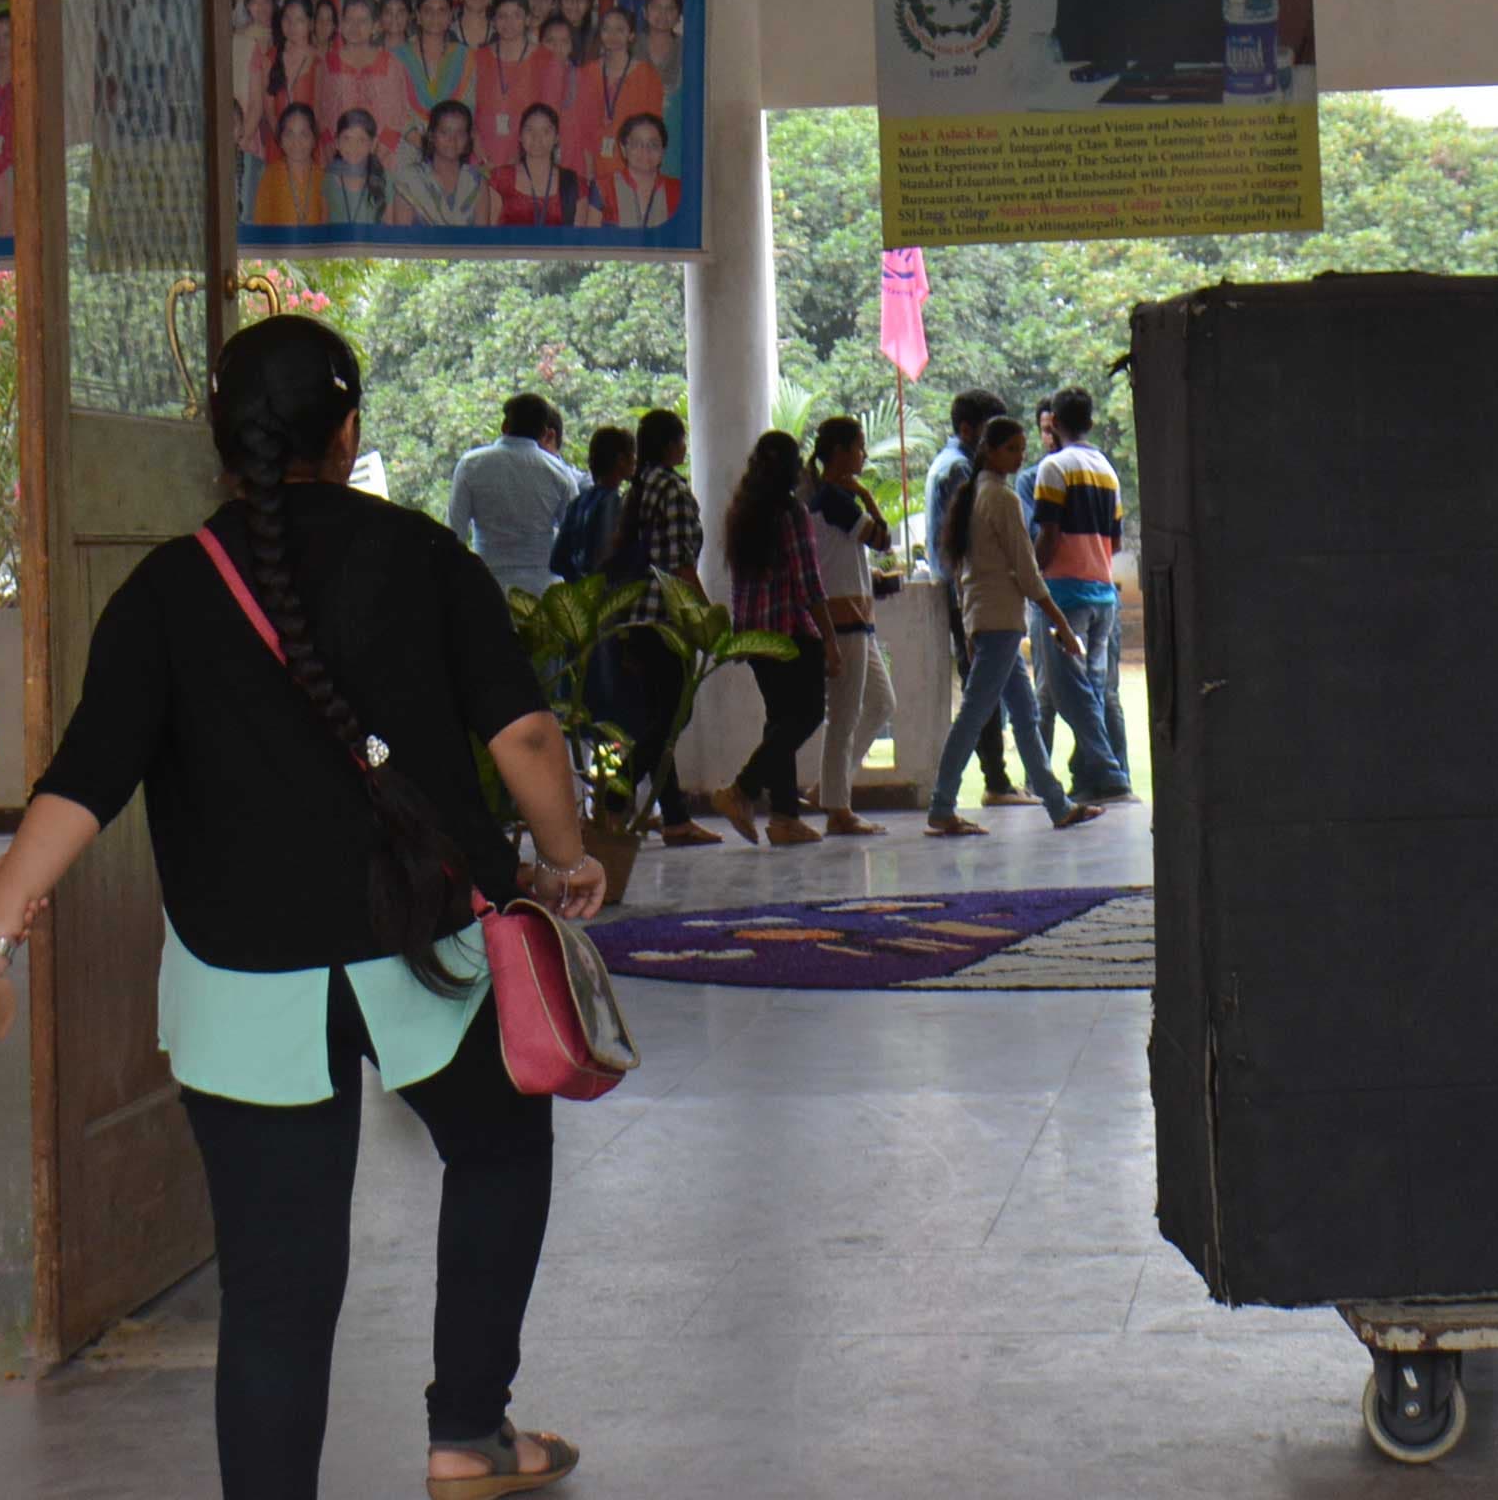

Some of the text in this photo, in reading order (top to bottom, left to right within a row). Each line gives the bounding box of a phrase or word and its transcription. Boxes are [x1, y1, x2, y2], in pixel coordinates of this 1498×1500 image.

[1023, 124, 1049, 136] Man
[1068, 122, 1101, 134] Great
[1105, 119, 1143, 132] Vision
[1147, 118, 1169, 130] and
[1173, 116, 1206, 129] Noble
[1212, 115, 1243, 127] Ideas
[1247, 113, 1274, 125] with
[1278, 112, 1295, 124] the
[900, 146, 928, 158] Main
[935, 143, 988, 160] Objective
[1010, 139, 1073, 156] Integrating
[1078, 137, 1108, 150] Class
[1115, 135, 1148, 148] Room
[1154, 133, 1205, 149] Learning
[1206, 131, 1234, 143] with
[1240, 130, 1256, 142] the
[1261, 128, 1297, 141] Actual
[898, 162, 930, 174] Work
[935, 158, 997, 176] Experience
[1077, 154, 1098, 166] The
[1102, 152, 1142, 168] Society
[1160, 147, 1230, 162] Constituted
[1249, 144, 1299, 157] Promote
[900, 177, 952, 190] Standard
[1023, 172, 1044, 184] and
[1073, 168, 1136, 182] Embedded
[1141, 166, 1166, 179] with
[1257, 160, 1302, 173] Doctors
[978, 189, 1026, 206] Lawyers
[1030, 188, 1052, 200] and
[1142, 183, 1162, 195] The
[1167, 181, 1205, 197] society
[1250, 176, 1298, 193] colleges
[901, 226, 933, 238] under
[956, 222, 1010, 235] Umbrella
[1133, 215, 1158, 227] Near
[950, 207, 989, 223] College
